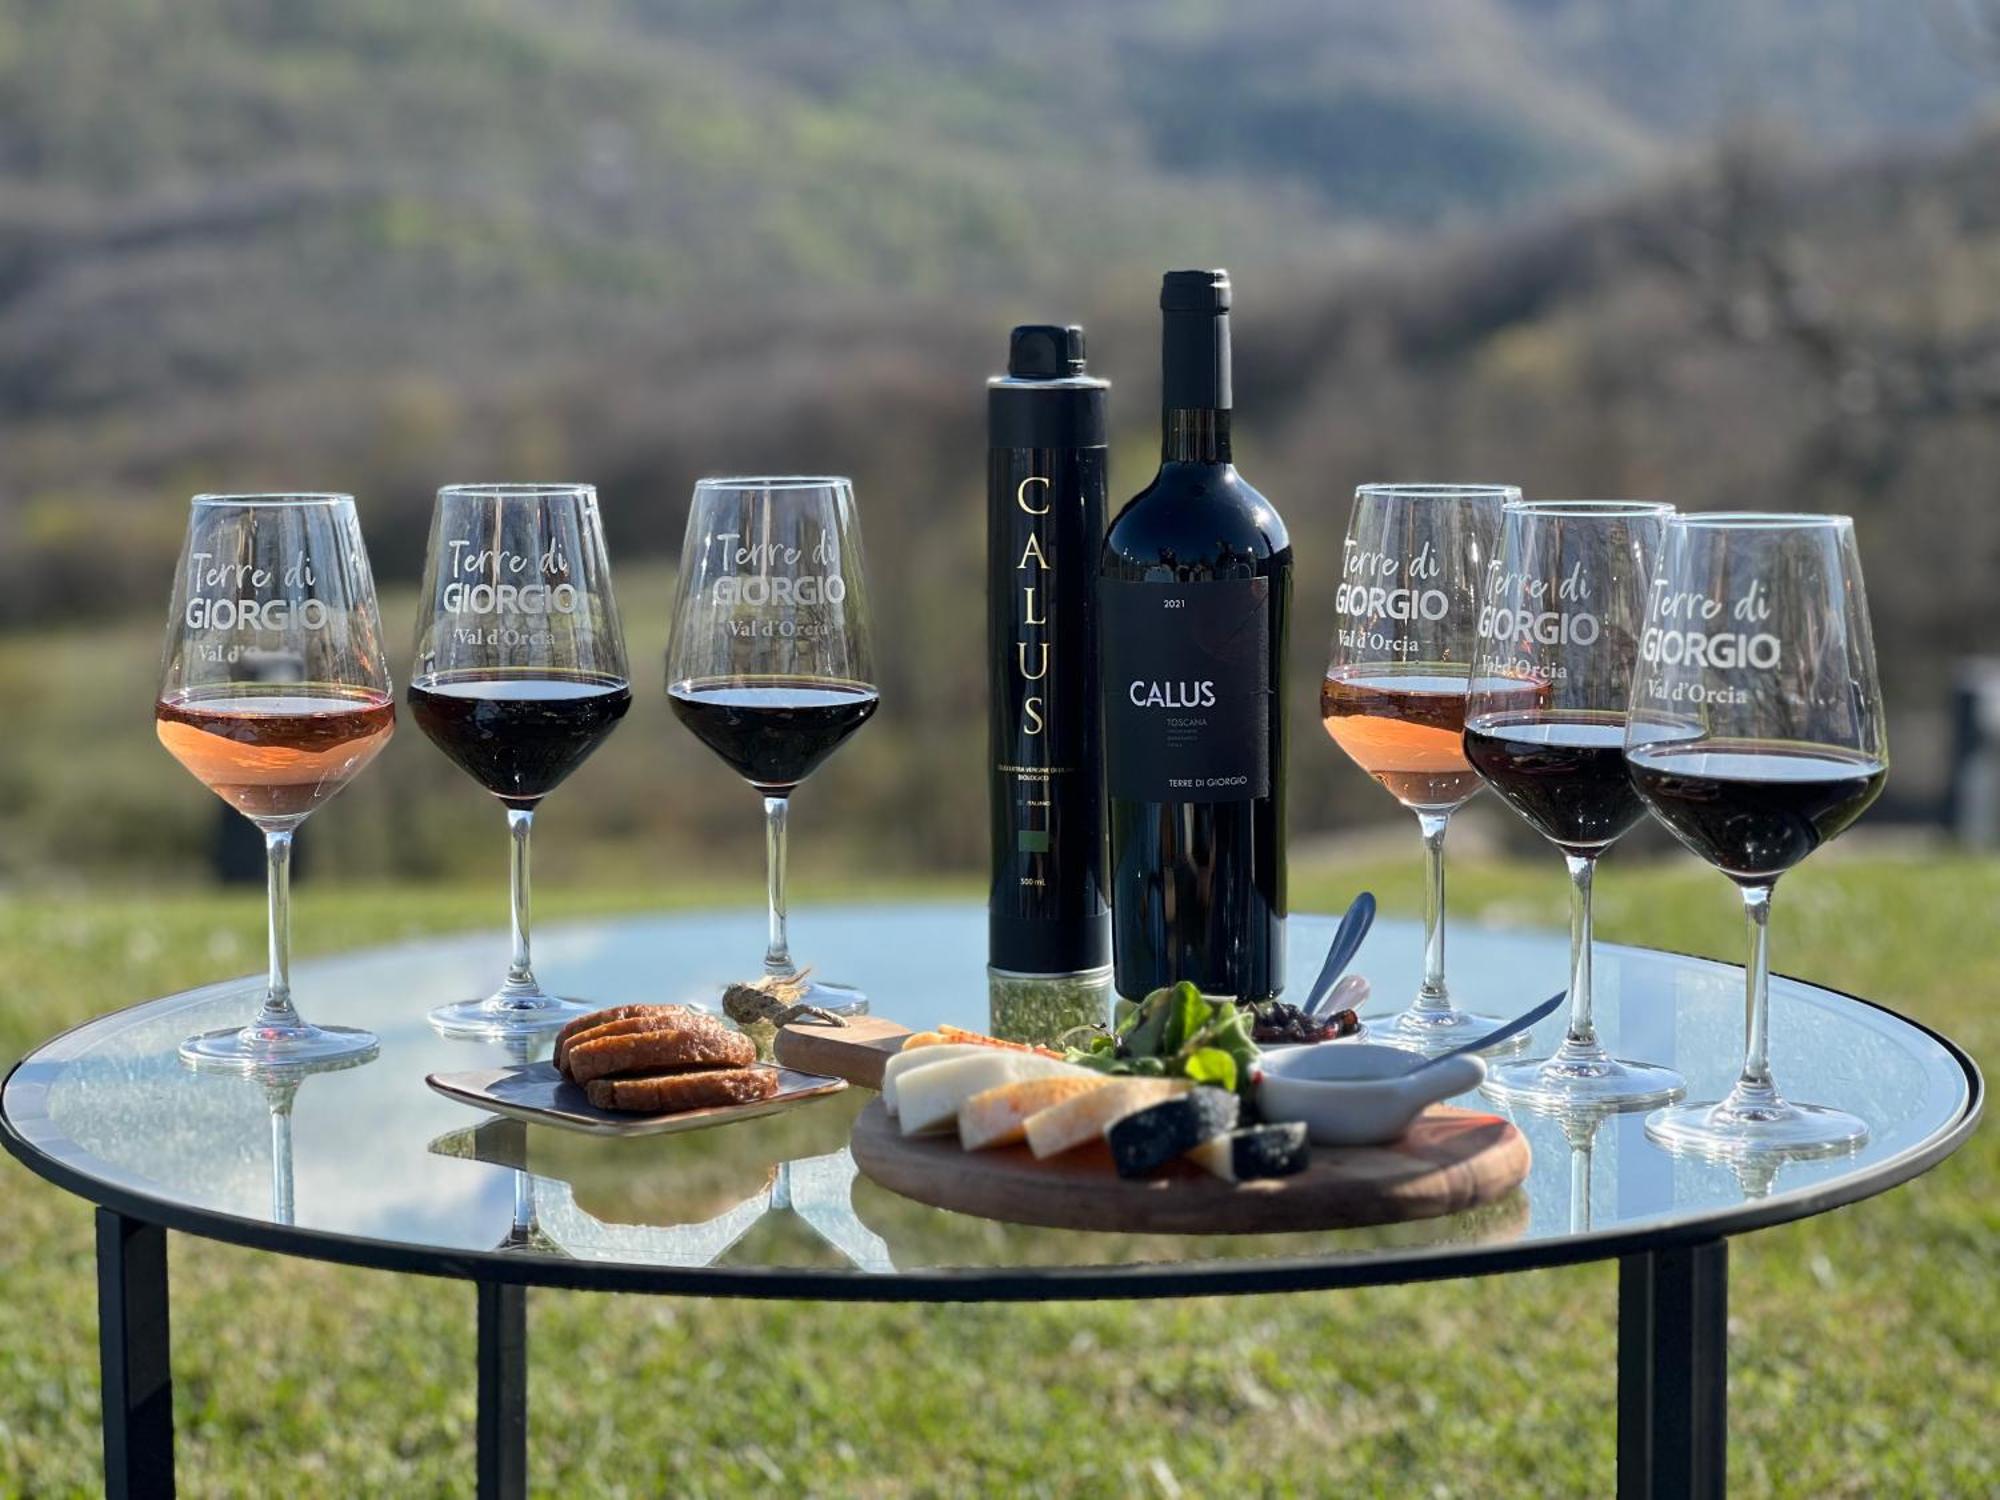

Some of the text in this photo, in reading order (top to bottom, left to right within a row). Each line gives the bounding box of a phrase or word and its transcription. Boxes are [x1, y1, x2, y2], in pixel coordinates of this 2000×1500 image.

[449, 536, 567, 578] Terre di
[717, 529, 837, 571] Terre di
[1344, 536, 1440, 580] Terre di
[192, 551, 316, 592] Terre di
[1487, 560, 1591, 602] Terre di
[443, 582, 577, 614] GIORGIO
[714, 575, 846, 606] GIORGIO
[1016, 477, 1051, 735] CALUS
[1163, 600, 1185, 608] 2021
[1335, 583, 1449, 620] GIORGIO
[1653, 579, 1771, 622] Terre di
[186, 598, 327, 631] GIORGIO
[730, 621, 756, 637] Val
[1478, 606, 1599, 646] GIORGIO
[198, 645, 226, 662] Val
[454, 629, 482, 645] Val
[1338, 629, 1355, 647] Val
[1642, 627, 1780, 669] GIORGIO
[1130, 681, 1216, 707] CALUS
[1648, 679, 1667, 699] Val
[1169, 776, 1247, 788] TERRE DI GIORGIO
